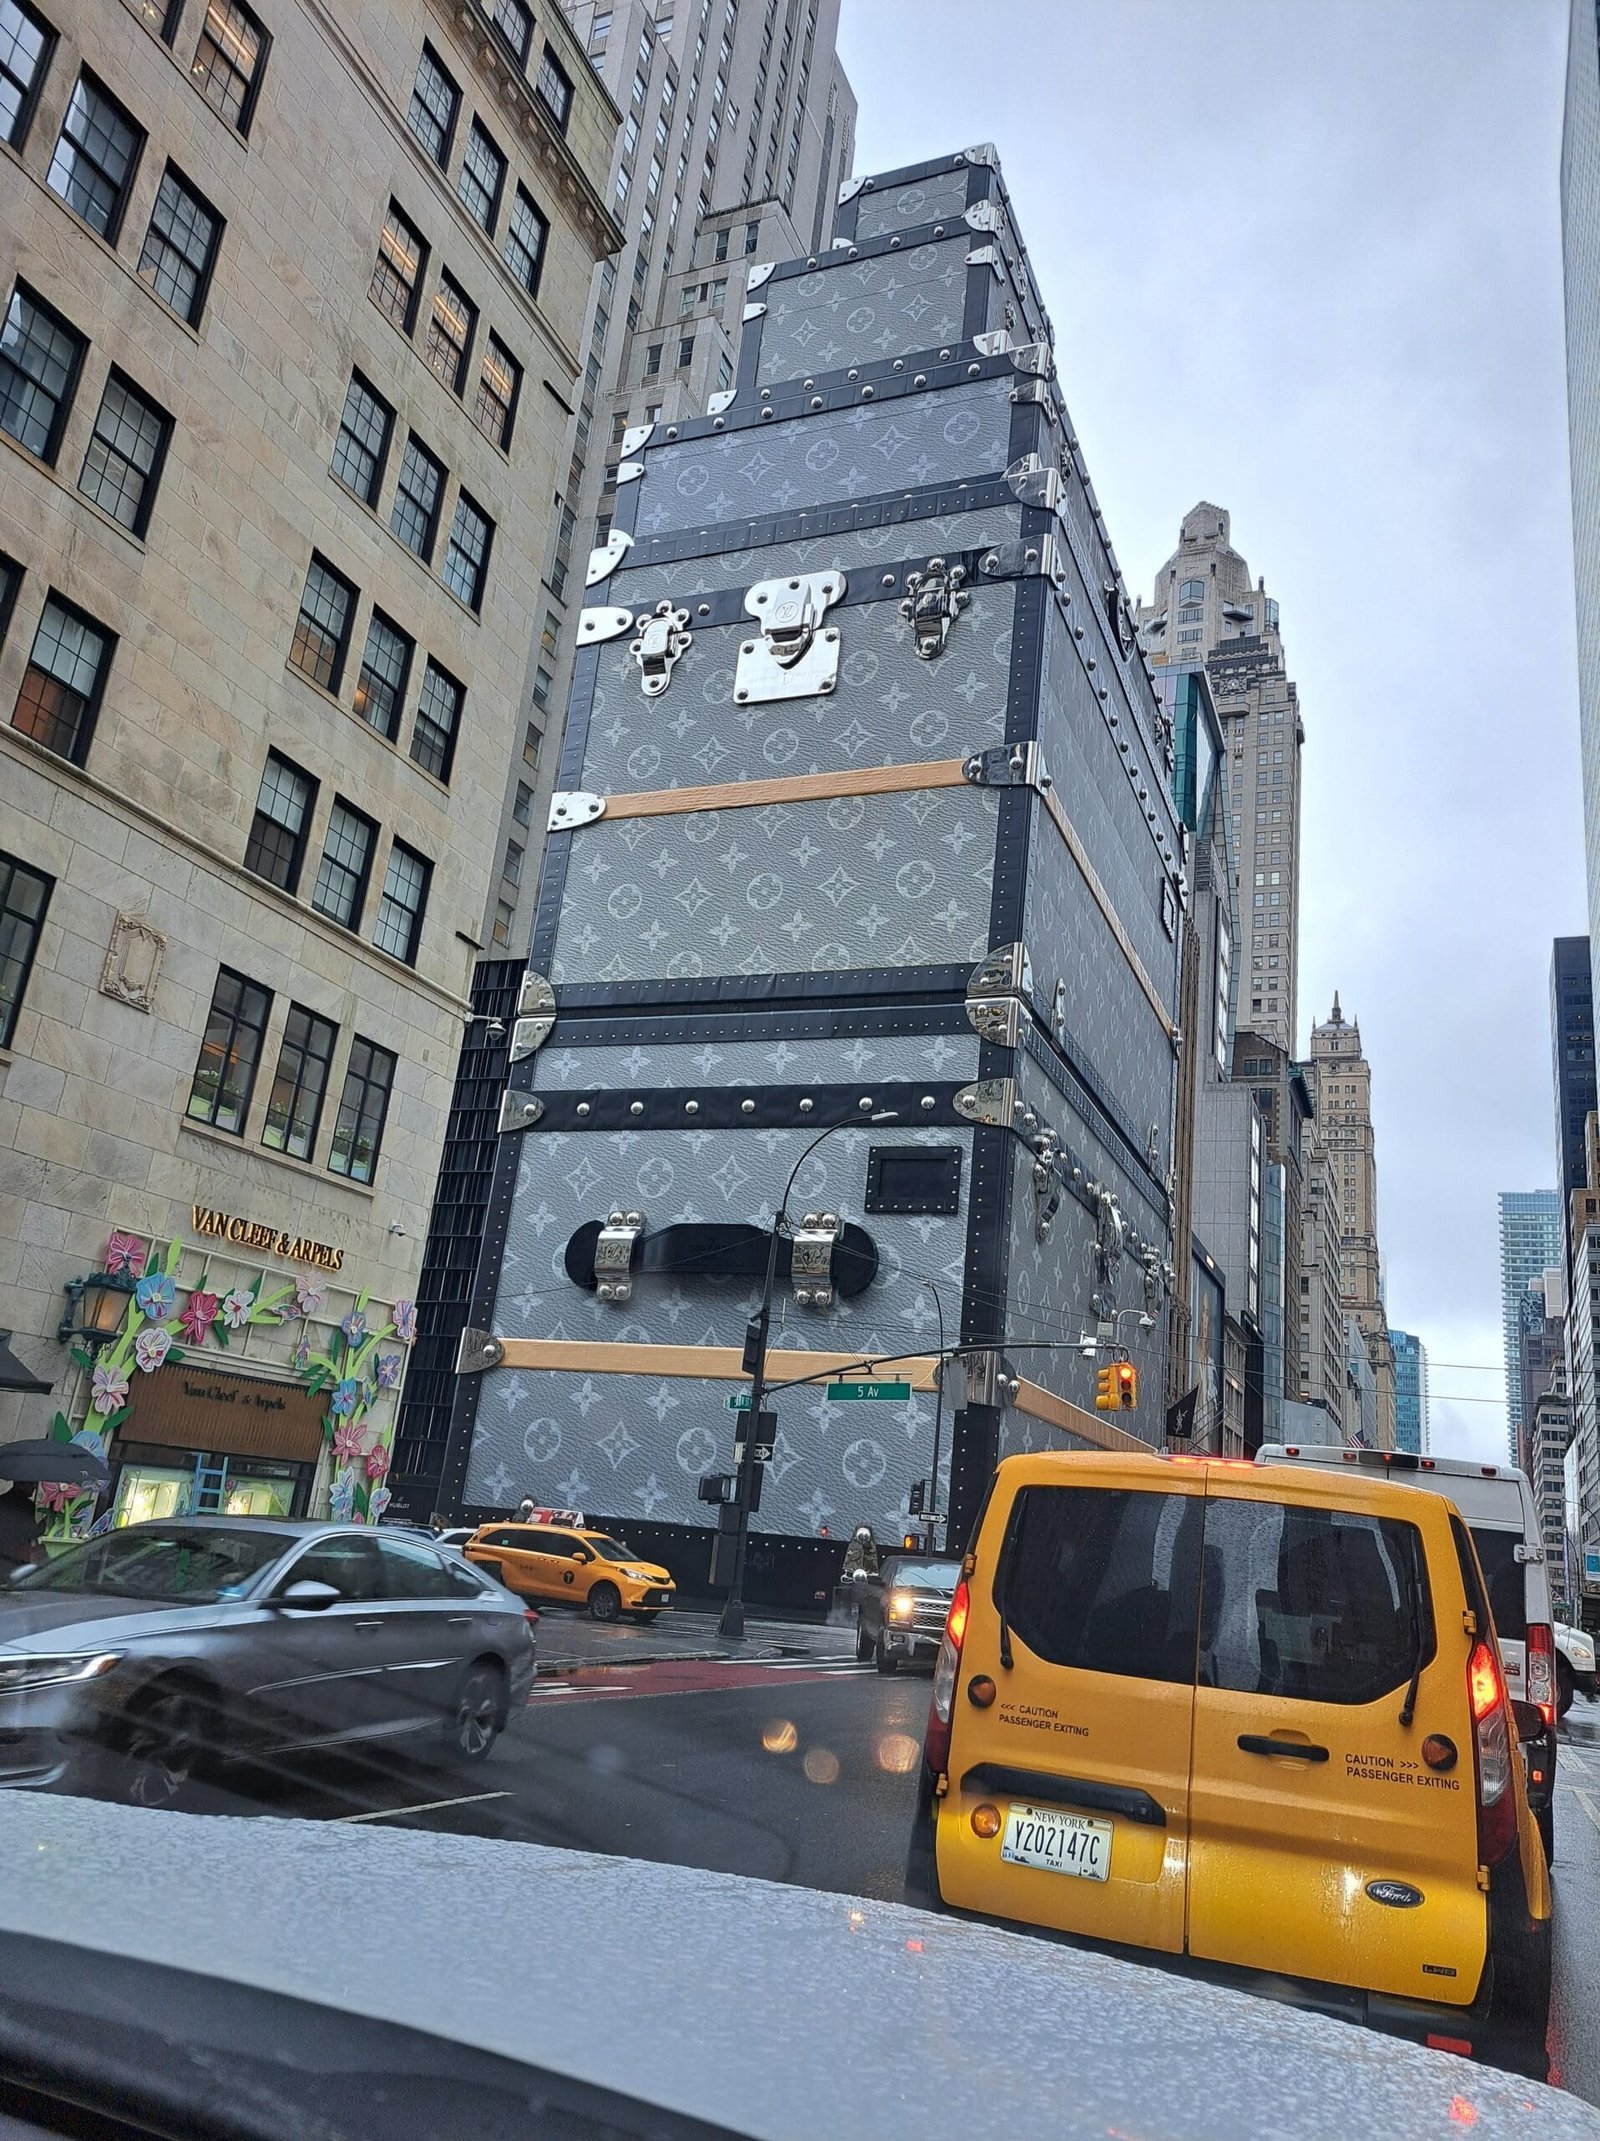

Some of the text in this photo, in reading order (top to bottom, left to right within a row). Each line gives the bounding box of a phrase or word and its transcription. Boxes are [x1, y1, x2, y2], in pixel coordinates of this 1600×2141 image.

[193, 1204, 344, 1271] VAN CLEEF & ARPELS
[857, 1385, 880, 1398] 5 Av
[1019, 1705, 1059, 1719] CAUTION
[999, 1714, 1089, 1737] PASSENGER EXITING
[1345, 1753, 1394, 1768] CAUTION
[1346, 1766, 1460, 1791] PASSENGER EXITING
[1034, 1812, 1087, 1830] NEW YORK
[1015, 1820, 1100, 1865] Y202147C
[1046, 1858, 1063, 1868] TAXI
[1380, 1884, 1412, 1903] Ford
